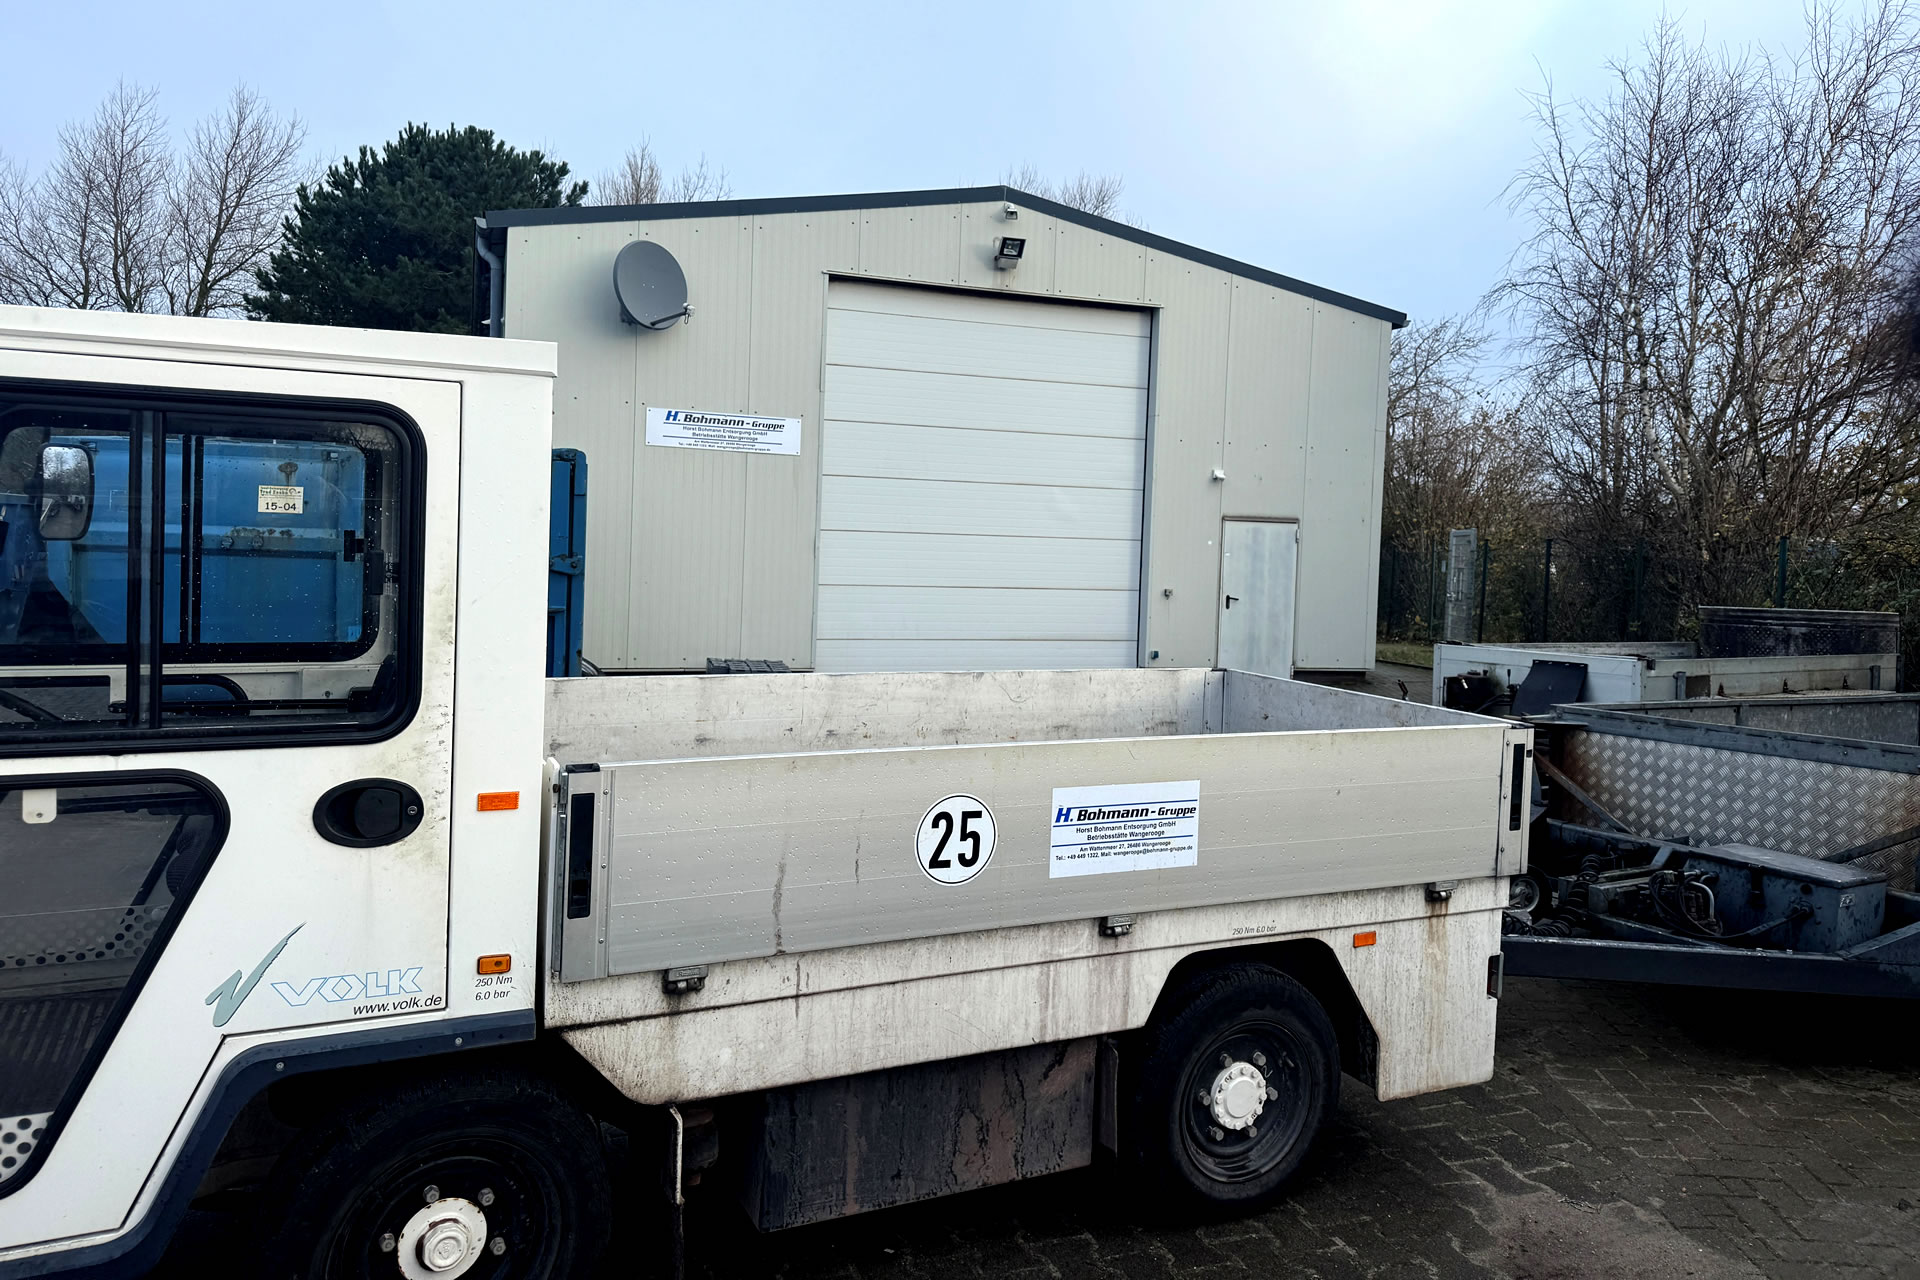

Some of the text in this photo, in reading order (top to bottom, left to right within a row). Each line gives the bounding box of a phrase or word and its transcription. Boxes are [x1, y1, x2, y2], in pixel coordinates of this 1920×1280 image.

[665, 410, 681, 422] H.
[265, 502, 297, 511] 15-04
[1055, 807, 1074, 823] H.
[1094, 824, 1122, 833] Bohmann
[1123, 822, 1157, 831] Entsorgung
[1158, 820, 1177, 828] GmbH
[928, 810, 983, 870] 25
[1087, 830, 1165, 840] Betriebsstätte Wangerooge
[1142, 840, 1171, 848] Wangerooge
[1232, 927, 1243, 935] 250
[1244, 926, 1255, 934] Nm
[271, 966, 423, 1007] VOLK
[475, 975, 513, 988] 250 Nm
[475, 990, 511, 1001] 6.0 bar
[353, 994, 442, 1015] www.volk.de
